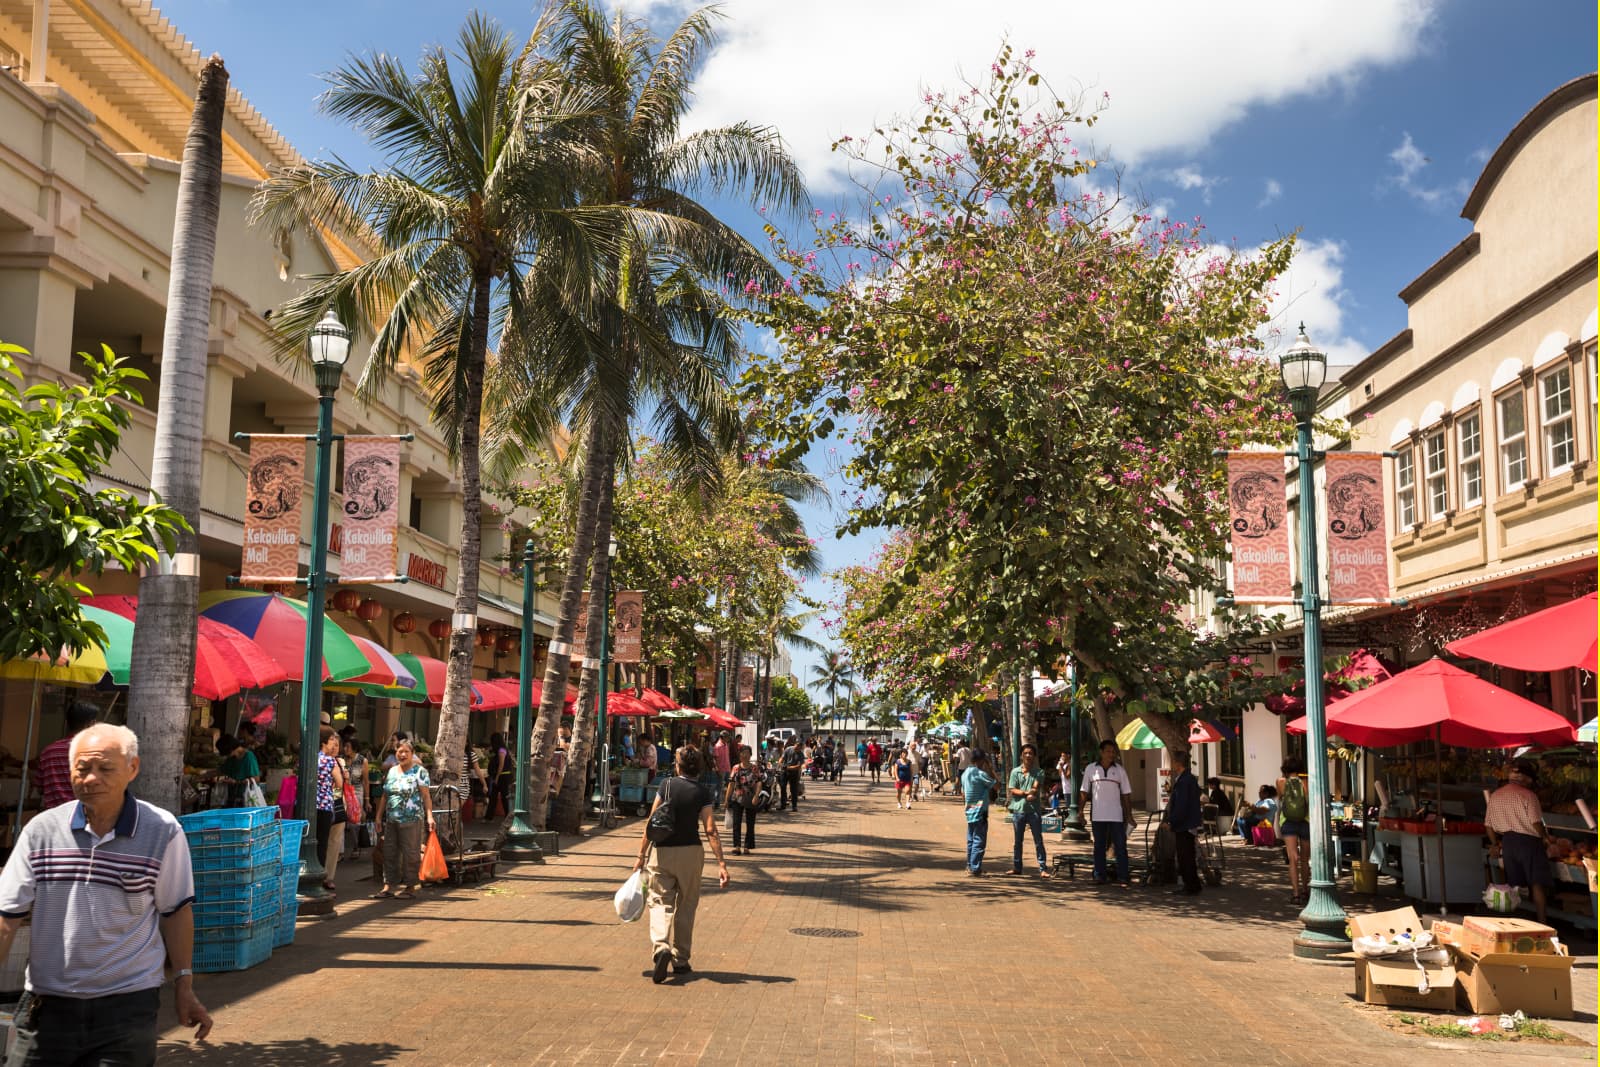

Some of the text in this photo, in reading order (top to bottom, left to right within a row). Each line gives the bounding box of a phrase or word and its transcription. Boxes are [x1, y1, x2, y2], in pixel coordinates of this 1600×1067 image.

[247, 527, 296, 544] Kekaulike
[345, 527, 393, 544] Kekaulike
[246, 547, 268, 563] Mall
[345, 547, 367, 563] Mall
[1236, 546, 1286, 563] Kekaulike
[1333, 548, 1384, 565] Kekaulike
[407, 552, 447, 588] MARKET
[1237, 565, 1260, 583] Mall
[1334, 567, 1357, 584] Mall
